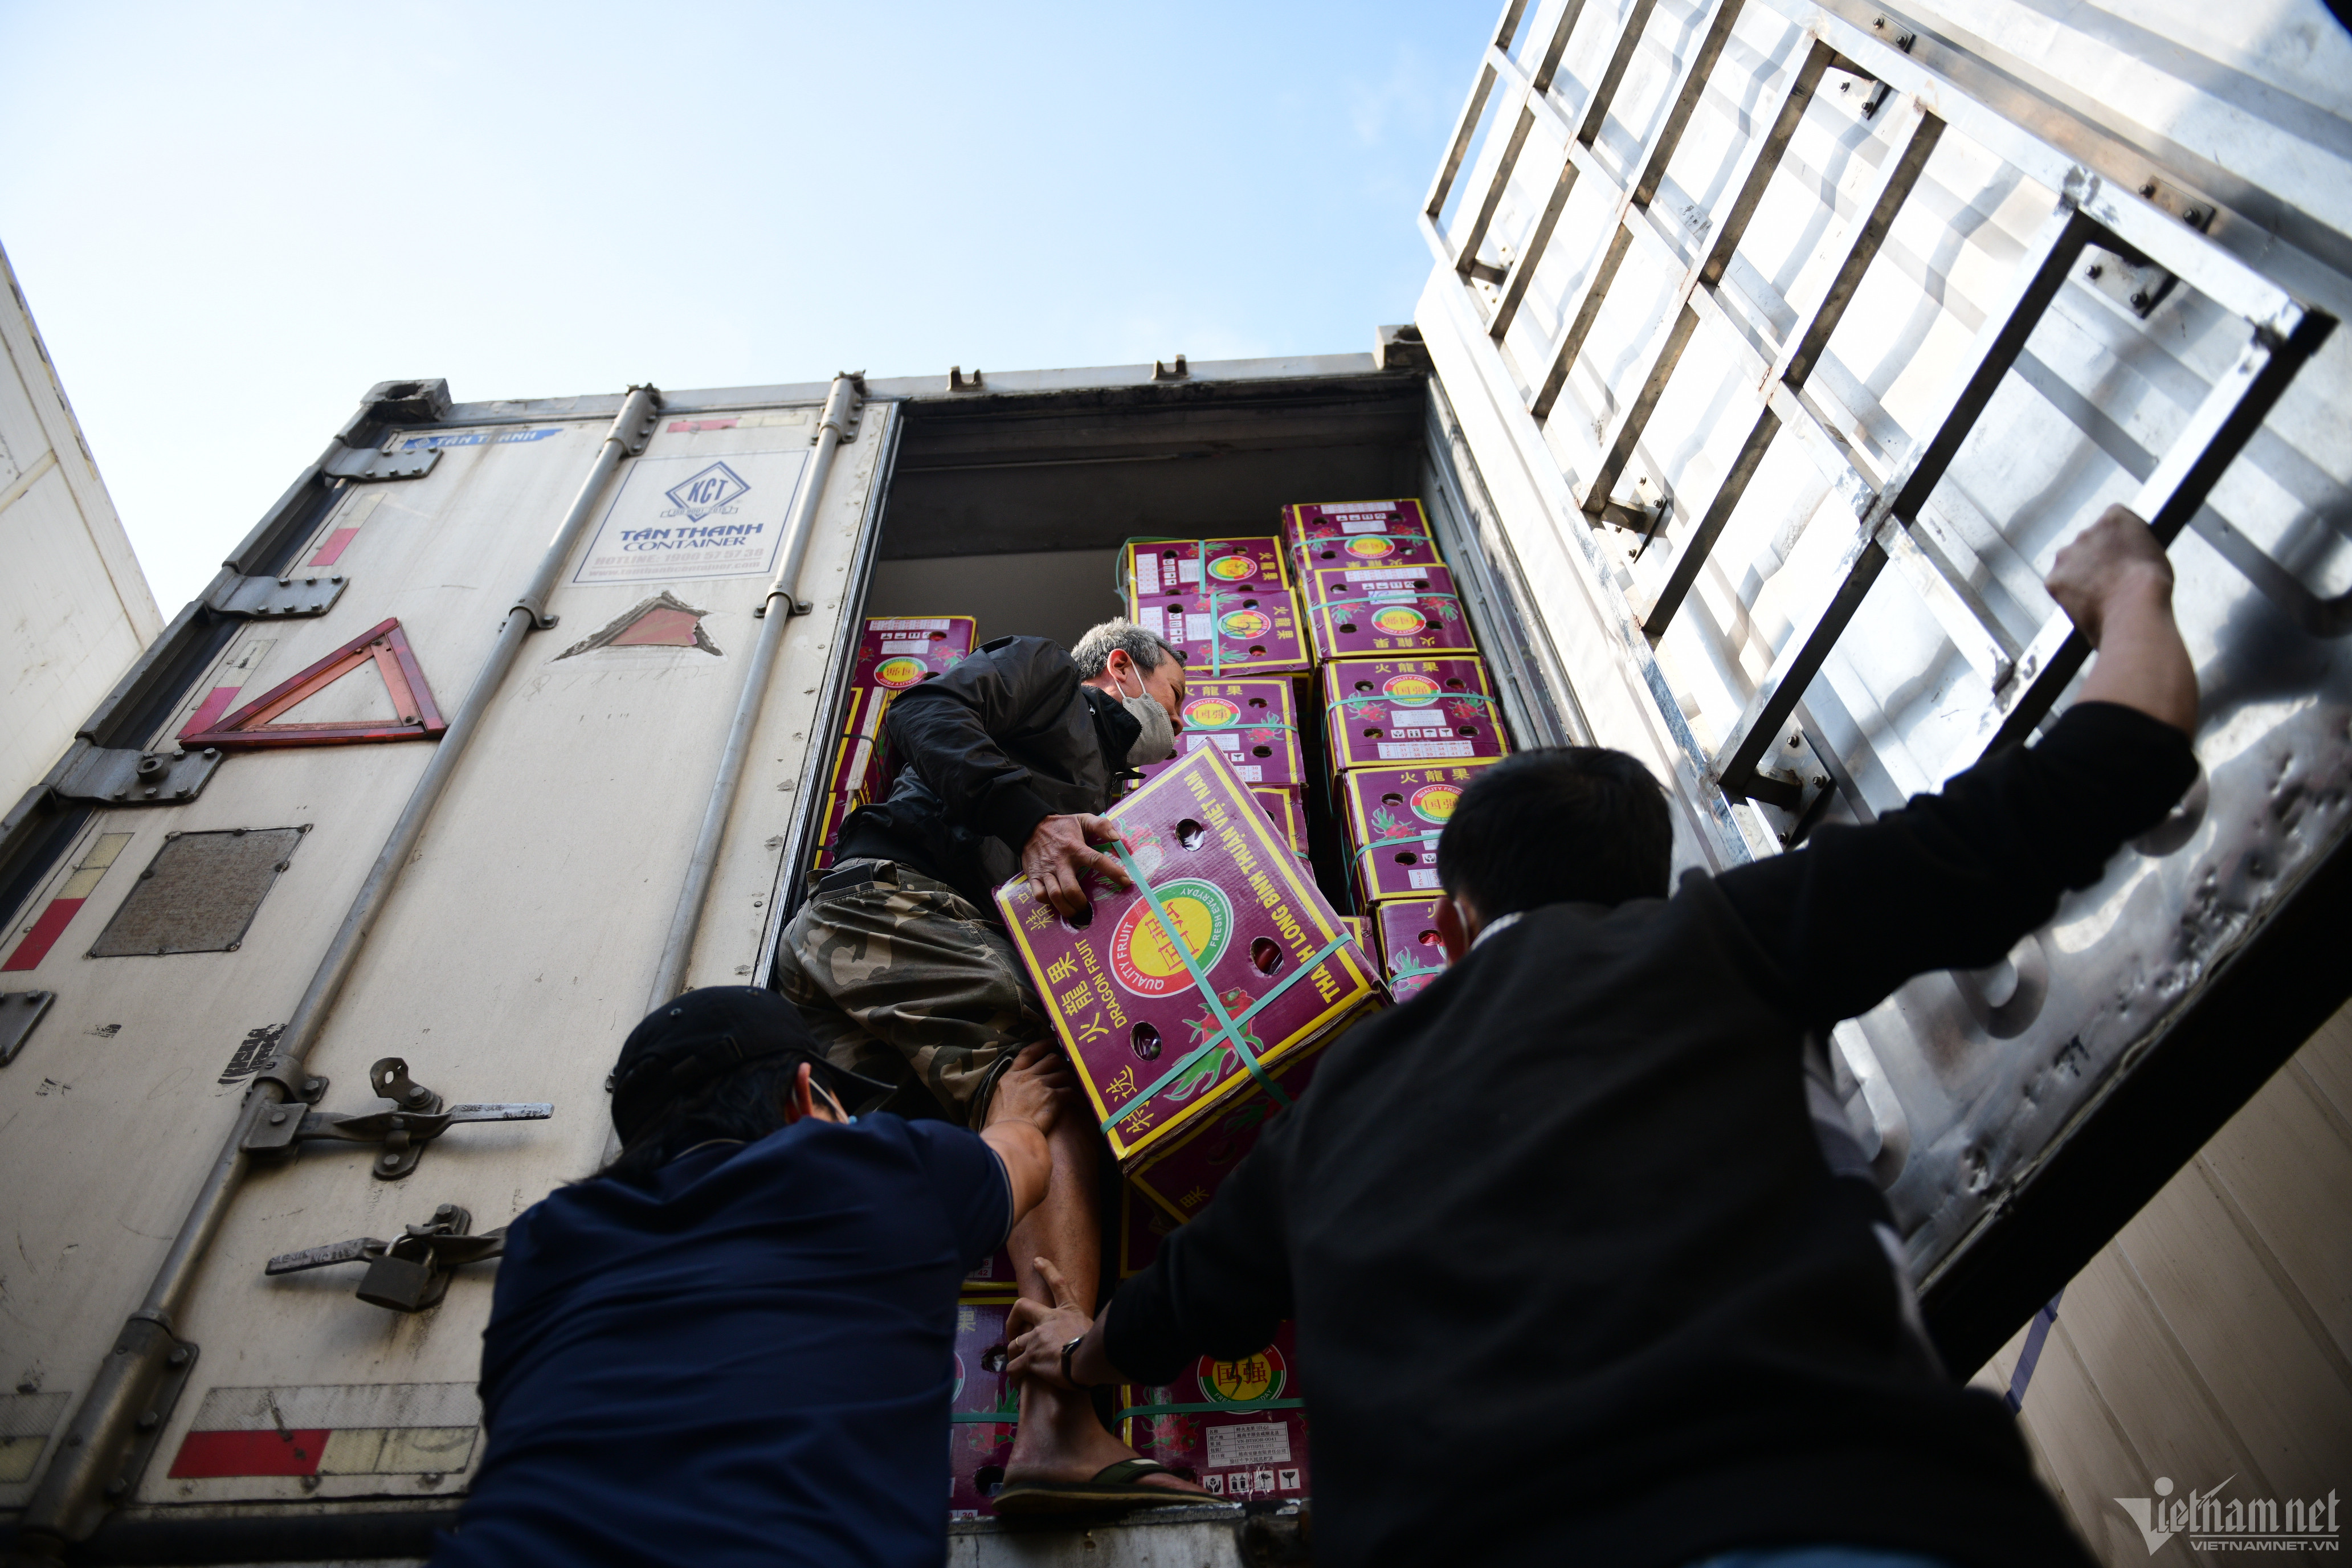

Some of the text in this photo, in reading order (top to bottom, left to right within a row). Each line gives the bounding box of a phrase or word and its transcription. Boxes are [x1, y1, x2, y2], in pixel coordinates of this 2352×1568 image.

[477, 431, 538, 442] TANH
[687, 477, 729, 504] KCT
[676, 523, 764, 537] THANH
[623, 536, 747, 552] CONTAINER
[1272, 606, 1294, 639] 火龍果
[1375, 662, 1439, 673] 火龍果
[1390, 676, 1431, 685] QUALITY FRUIT
[1191, 699, 1233, 709] QUALITY FRUIT
[1400, 768, 1471, 784] 火龍果
[1417, 786, 1442, 798] QUALITY
[1183, 770, 1341, 1004] THAH LONG BÌNH THUẬN VIỆT NAM
[1117, 921, 1165, 990] QUALITY FRUIT
[1075, 938, 1128, 1029] DRAGON FRUIT
[1047, 952, 1109, 1043] 火龍果
